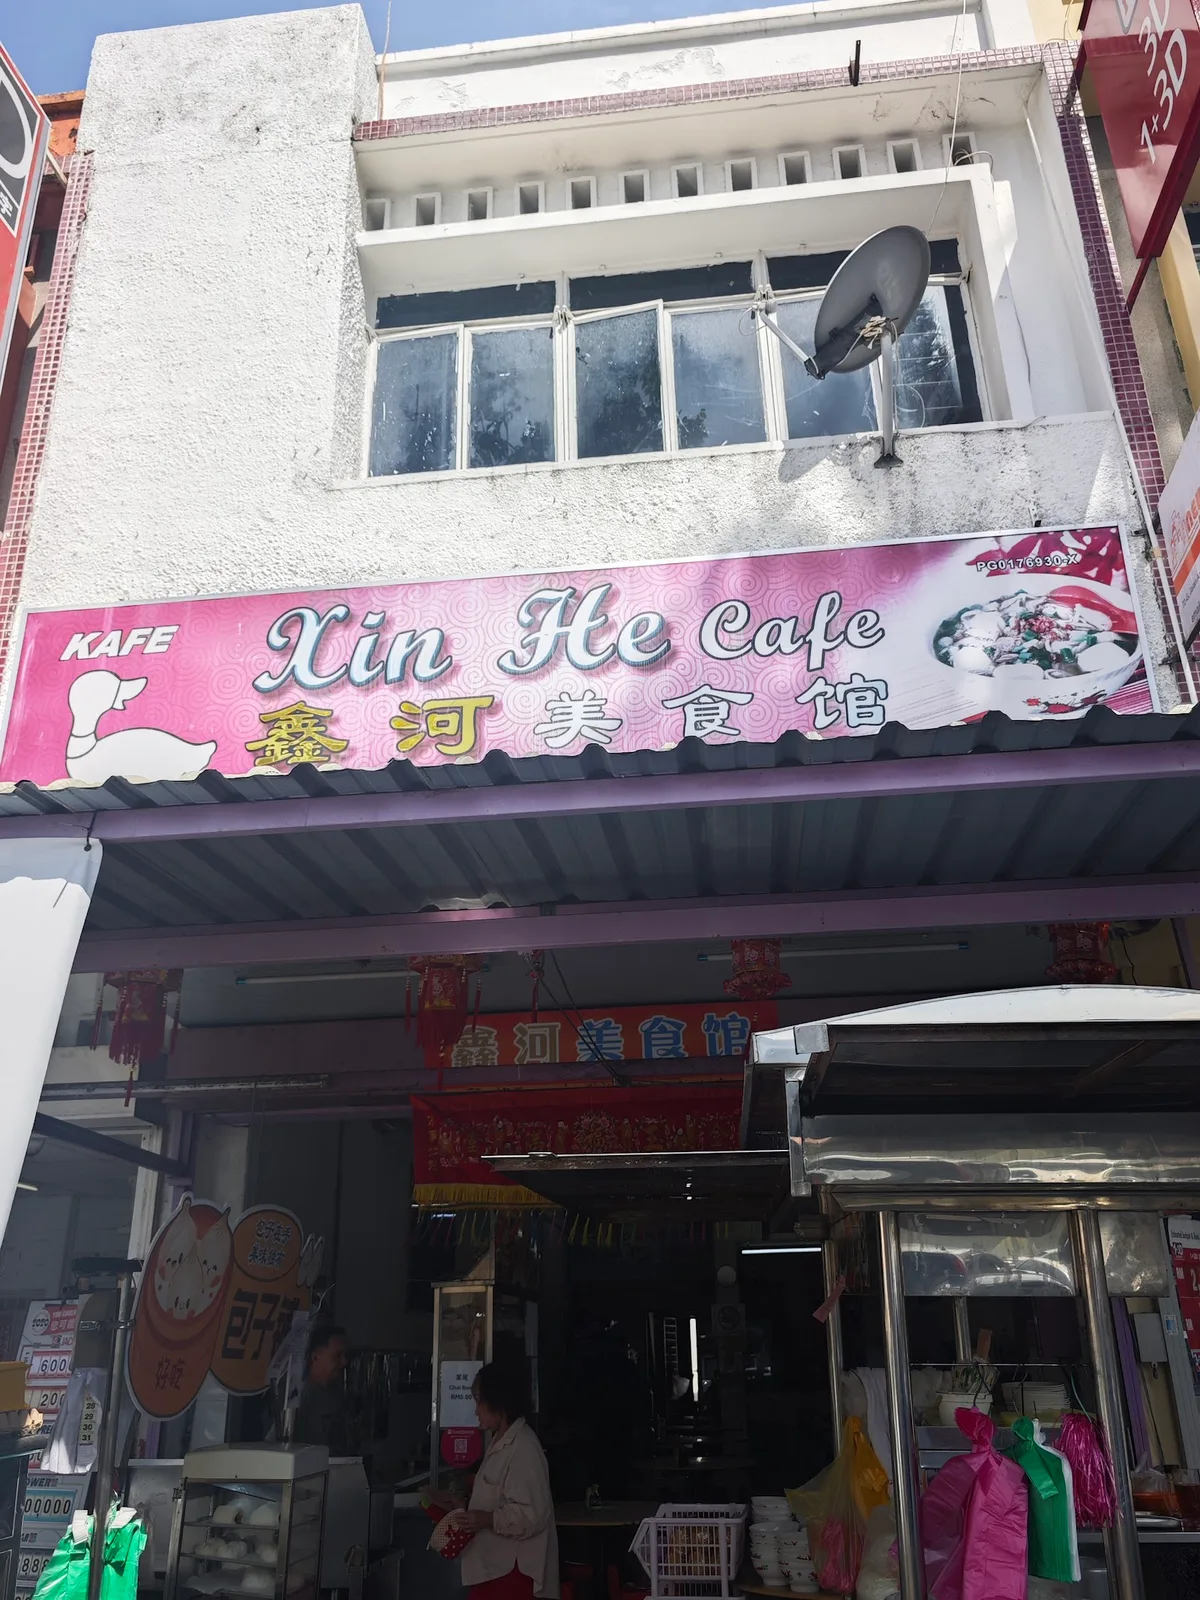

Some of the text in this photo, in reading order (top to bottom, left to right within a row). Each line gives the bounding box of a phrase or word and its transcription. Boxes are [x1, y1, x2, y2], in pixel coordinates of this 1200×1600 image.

[976, 553, 1079, 572] PG0176930-X
[60, 625, 180, 661] KAFE
[252, 583, 885, 694] Xin He Cafe
[245, 673, 888, 766] 鑫河美食馆
[450, 1011, 751, 1068] 鑫河美食馆
[62, 1336, 74, 1346] JAC
[25, 1478, 51, 1487] OWER
